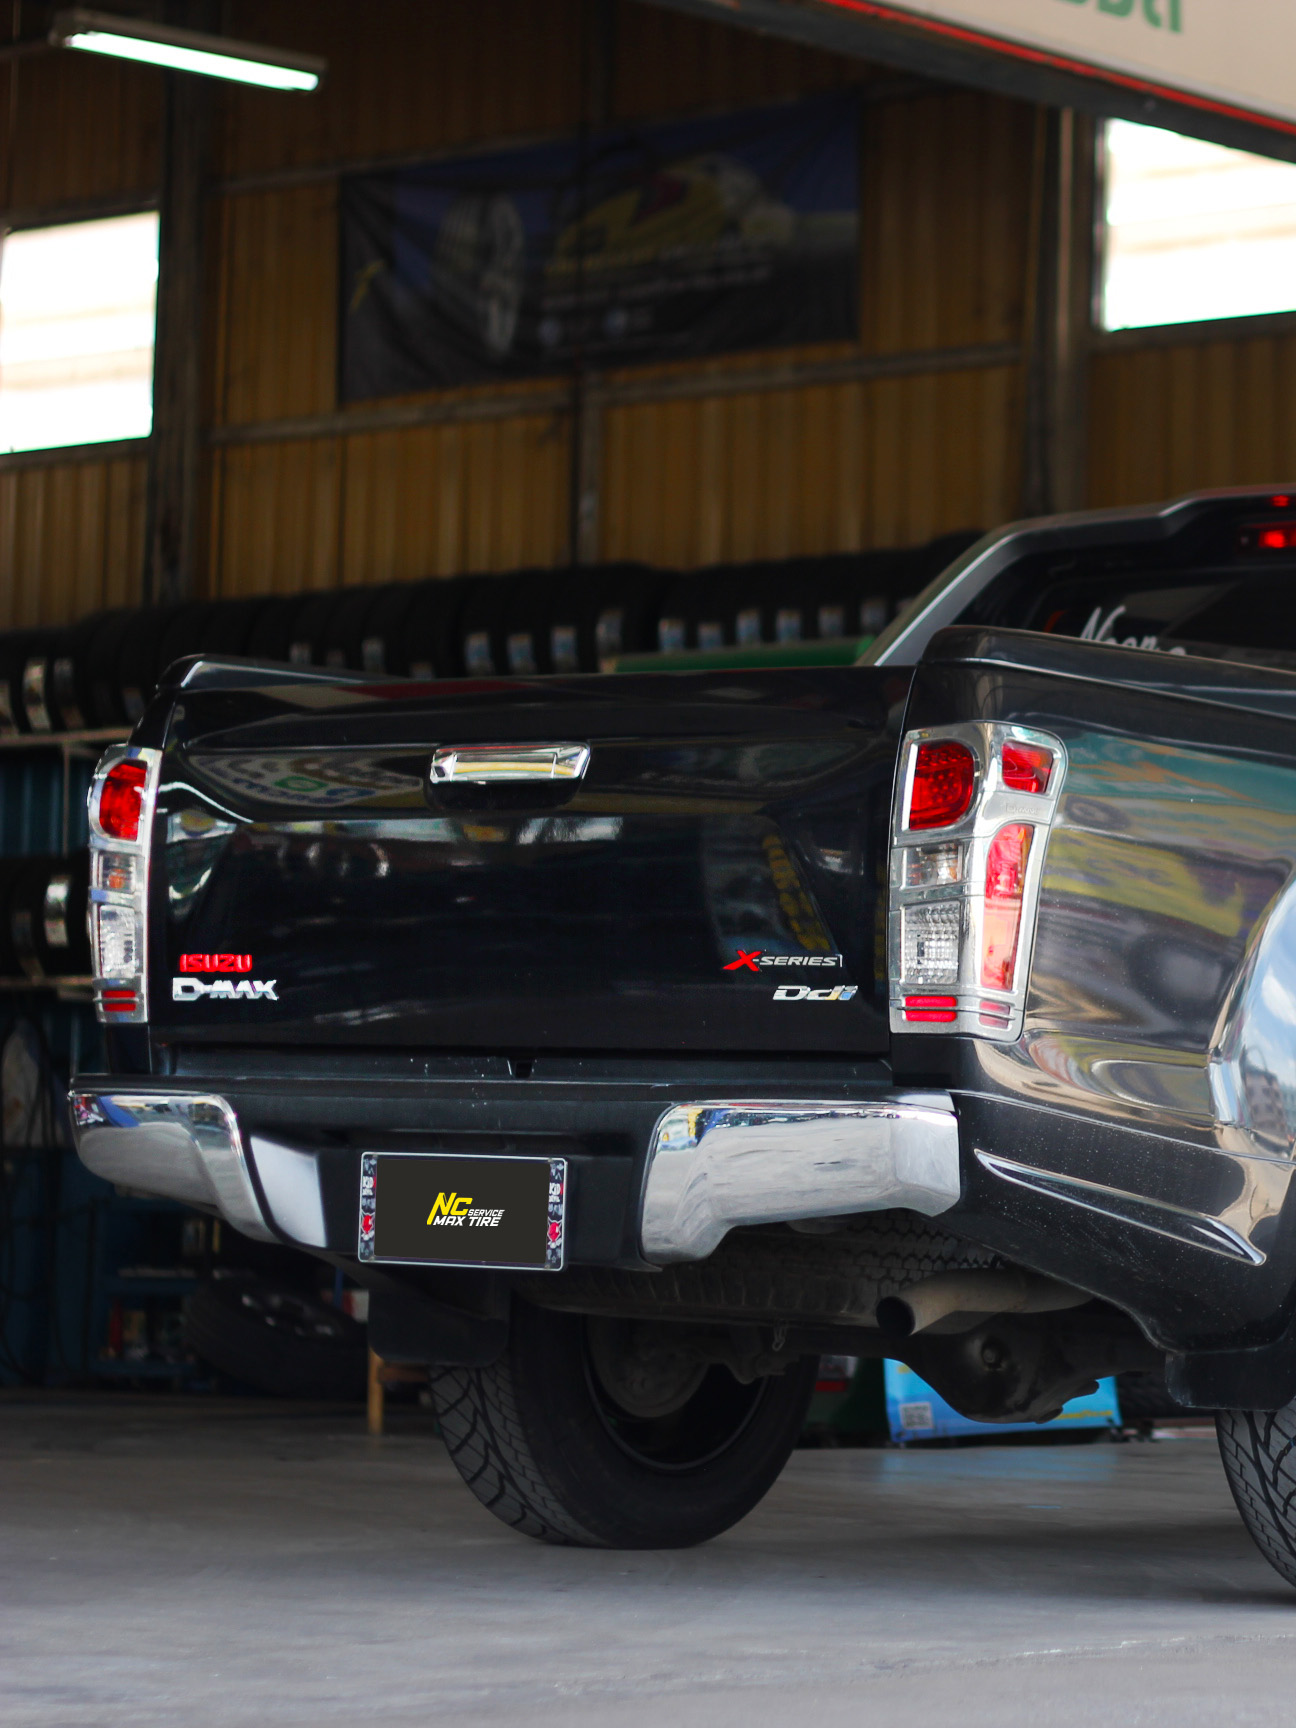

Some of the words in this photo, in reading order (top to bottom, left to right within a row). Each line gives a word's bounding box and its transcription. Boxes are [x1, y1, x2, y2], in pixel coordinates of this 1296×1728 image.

[180, 954, 252, 973] ISUZU
[722, 950, 838, 972] X-SERIES
[172, 977, 279, 1001] D-MAX
